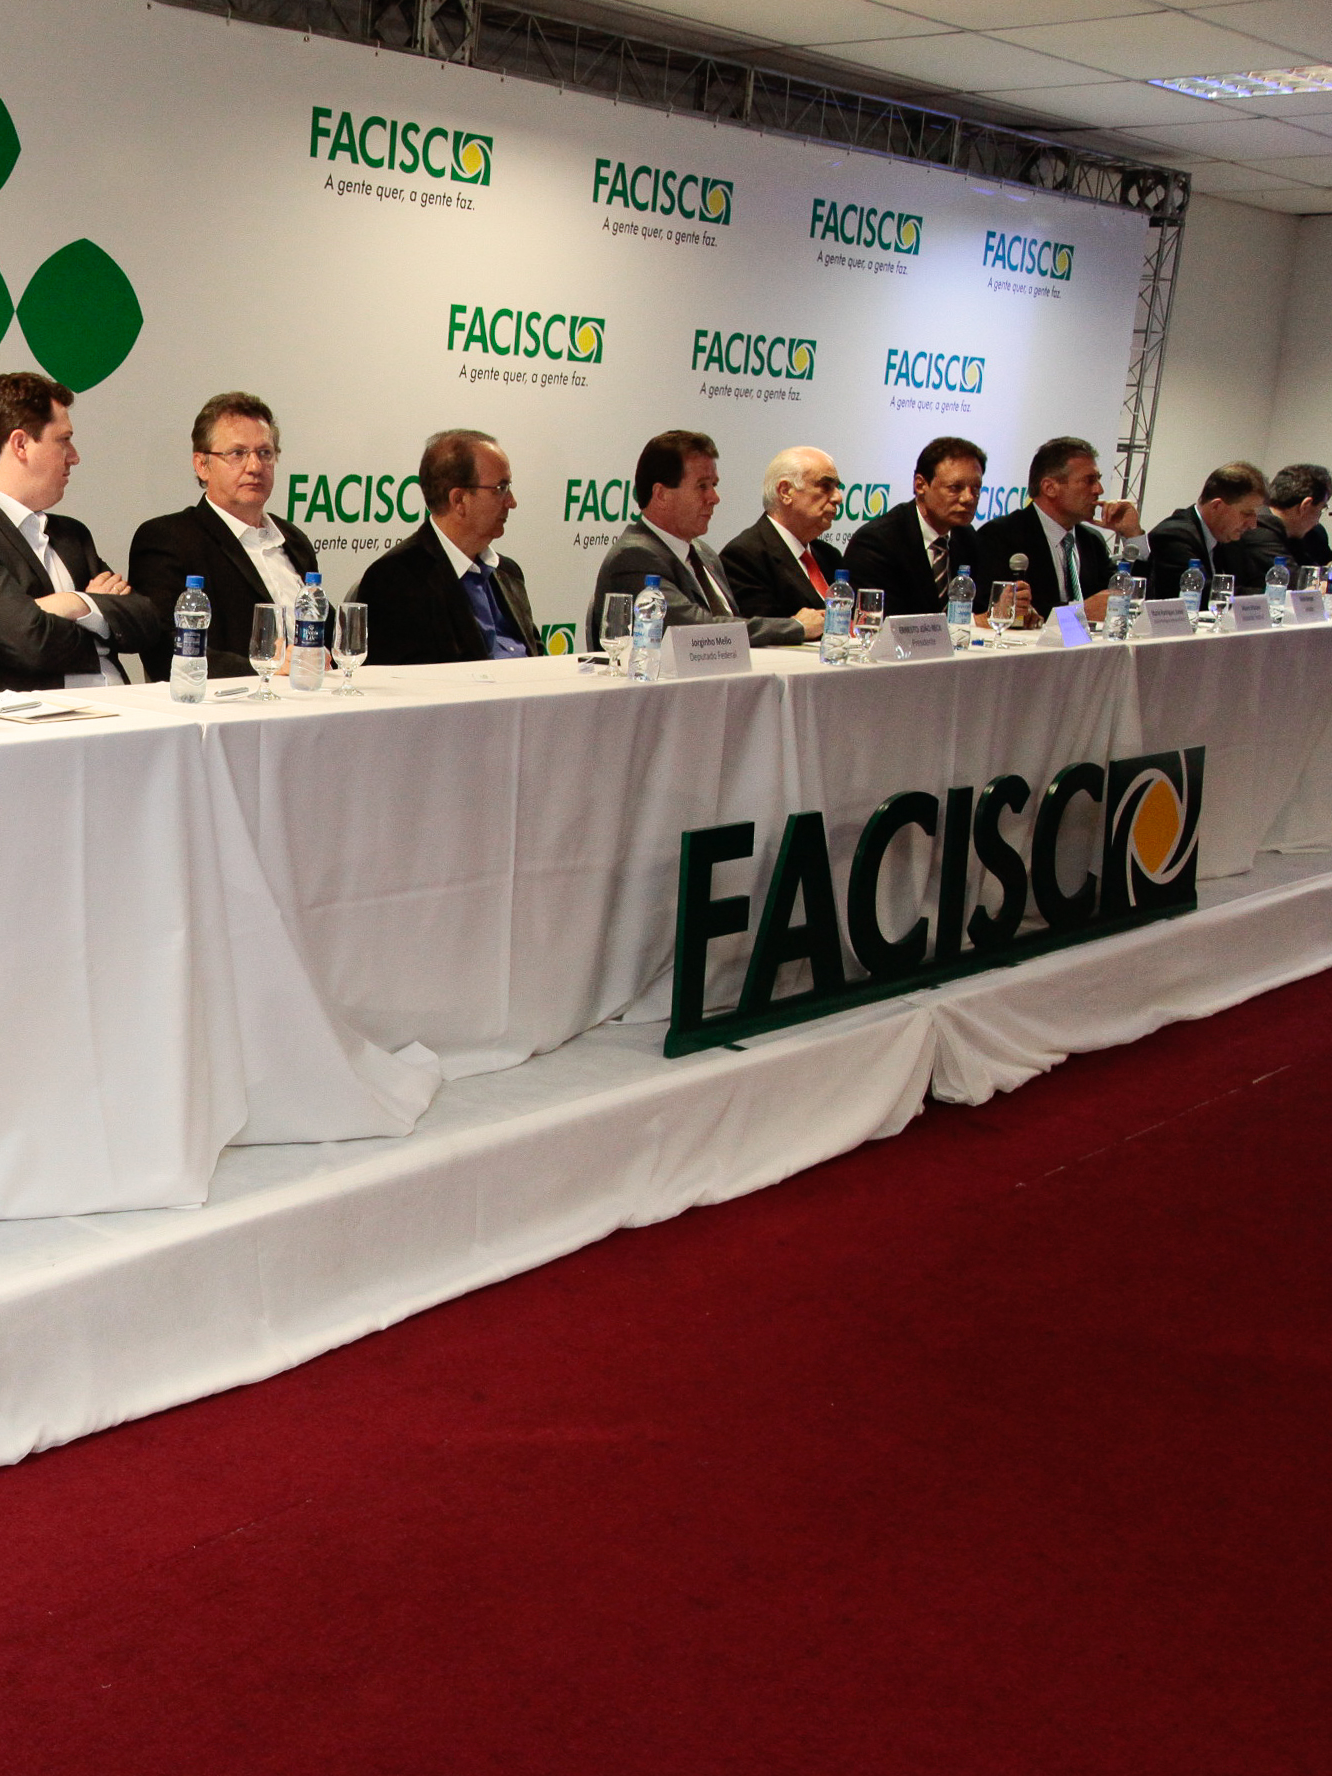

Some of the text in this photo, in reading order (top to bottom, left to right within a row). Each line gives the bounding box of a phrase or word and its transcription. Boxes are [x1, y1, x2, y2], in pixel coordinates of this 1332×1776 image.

[324, 173, 475, 211] A gente quer, a gente faz.
[602, 216, 718, 247] A gente quer, a gente faz.
[817, 250, 908, 275] A gente quer, a gente faz.
[459, 364, 589, 388] A gente quer, a gente faz.
[699, 382, 802, 402] A gente quer, a gente faz.
[314, 536, 348, 554] gente
[351, 537, 380, 554] quer,
[385, 538, 392, 549] a
[573, 532, 581, 546] A
[583, 533, 609, 549] gente
